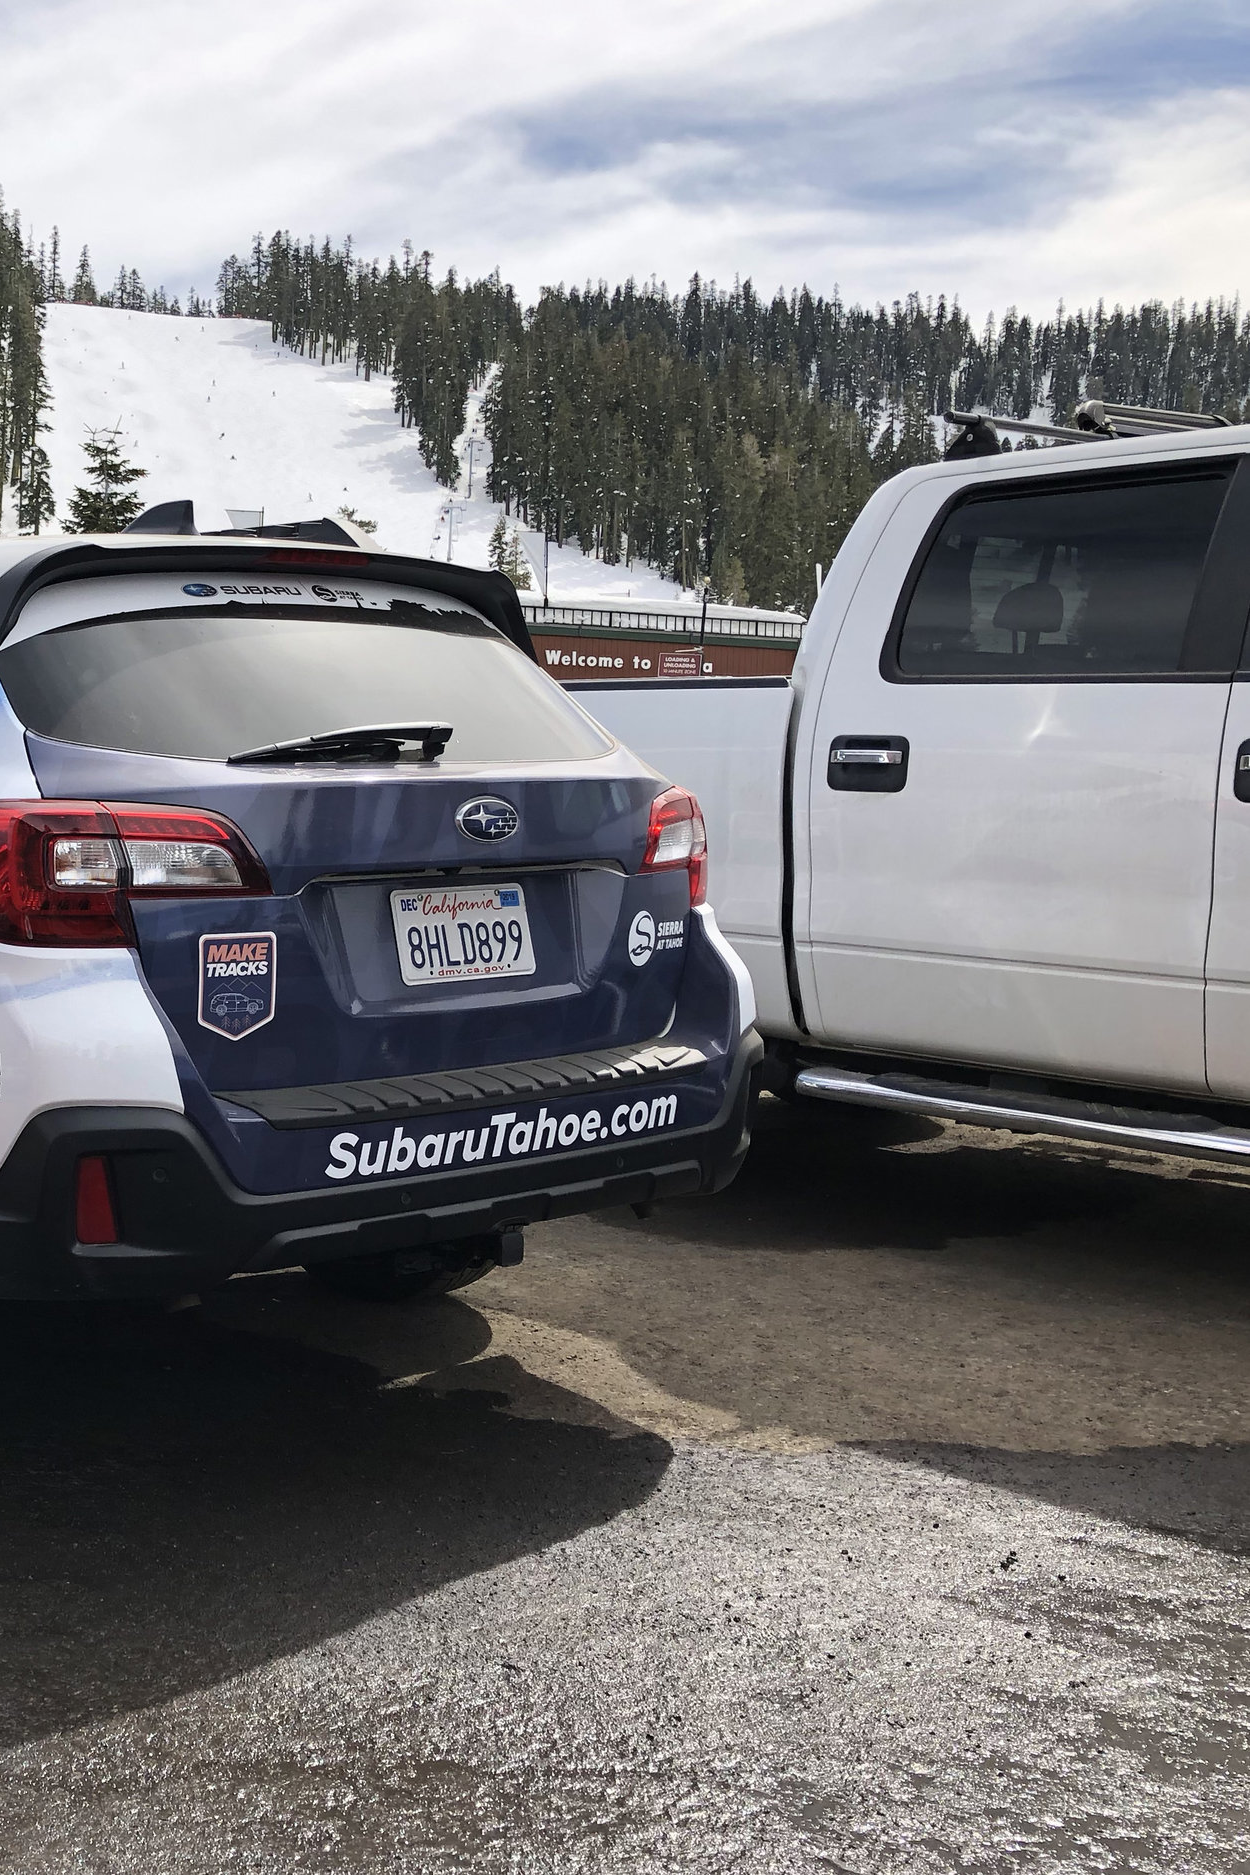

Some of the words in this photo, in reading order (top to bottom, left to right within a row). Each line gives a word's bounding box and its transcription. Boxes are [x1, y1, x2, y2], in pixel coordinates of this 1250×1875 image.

[220, 585, 302, 597] SUBARU
[545, 649, 624, 668] Welcome
[633, 656, 652, 669] to
[401, 898, 418, 912] DEC
[422, 893, 502, 920] California
[657, 920, 684, 937] SIERRA
[207, 942, 269, 962] MAKE
[407, 920, 523, 969] 8HLD899
[656, 939, 665, 950] AT
[665, 937, 684, 949] TAHOE
[206, 961, 269, 977] TRACKS
[438, 965, 505, 977] dmv.ca.gov
[324, 1094, 678, 1179] SubaruTahoe.com
